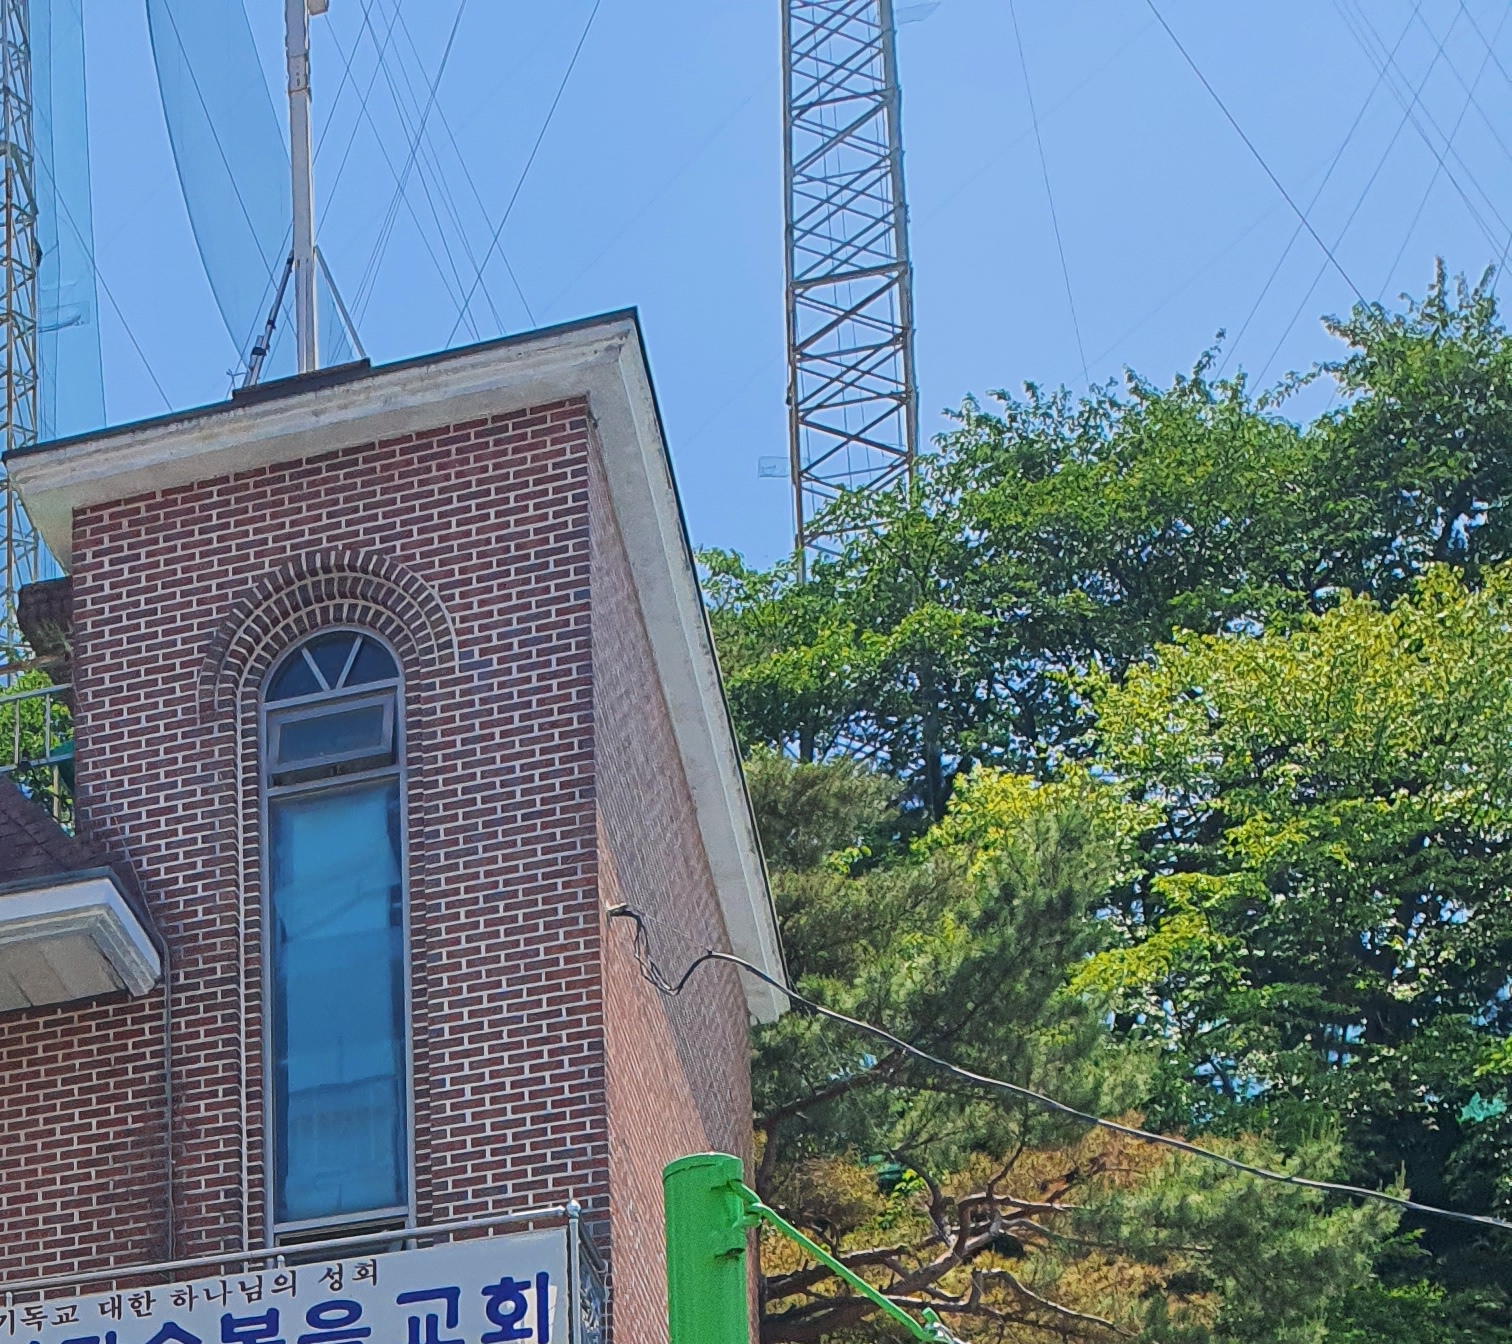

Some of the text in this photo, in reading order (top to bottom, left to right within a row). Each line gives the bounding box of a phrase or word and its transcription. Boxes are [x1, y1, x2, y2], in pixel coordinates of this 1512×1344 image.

[98, 1290, 157, 1321] 대한
[169, 1269, 297, 1312] 하나님의
[317, 1258, 378, 1292] 성회
